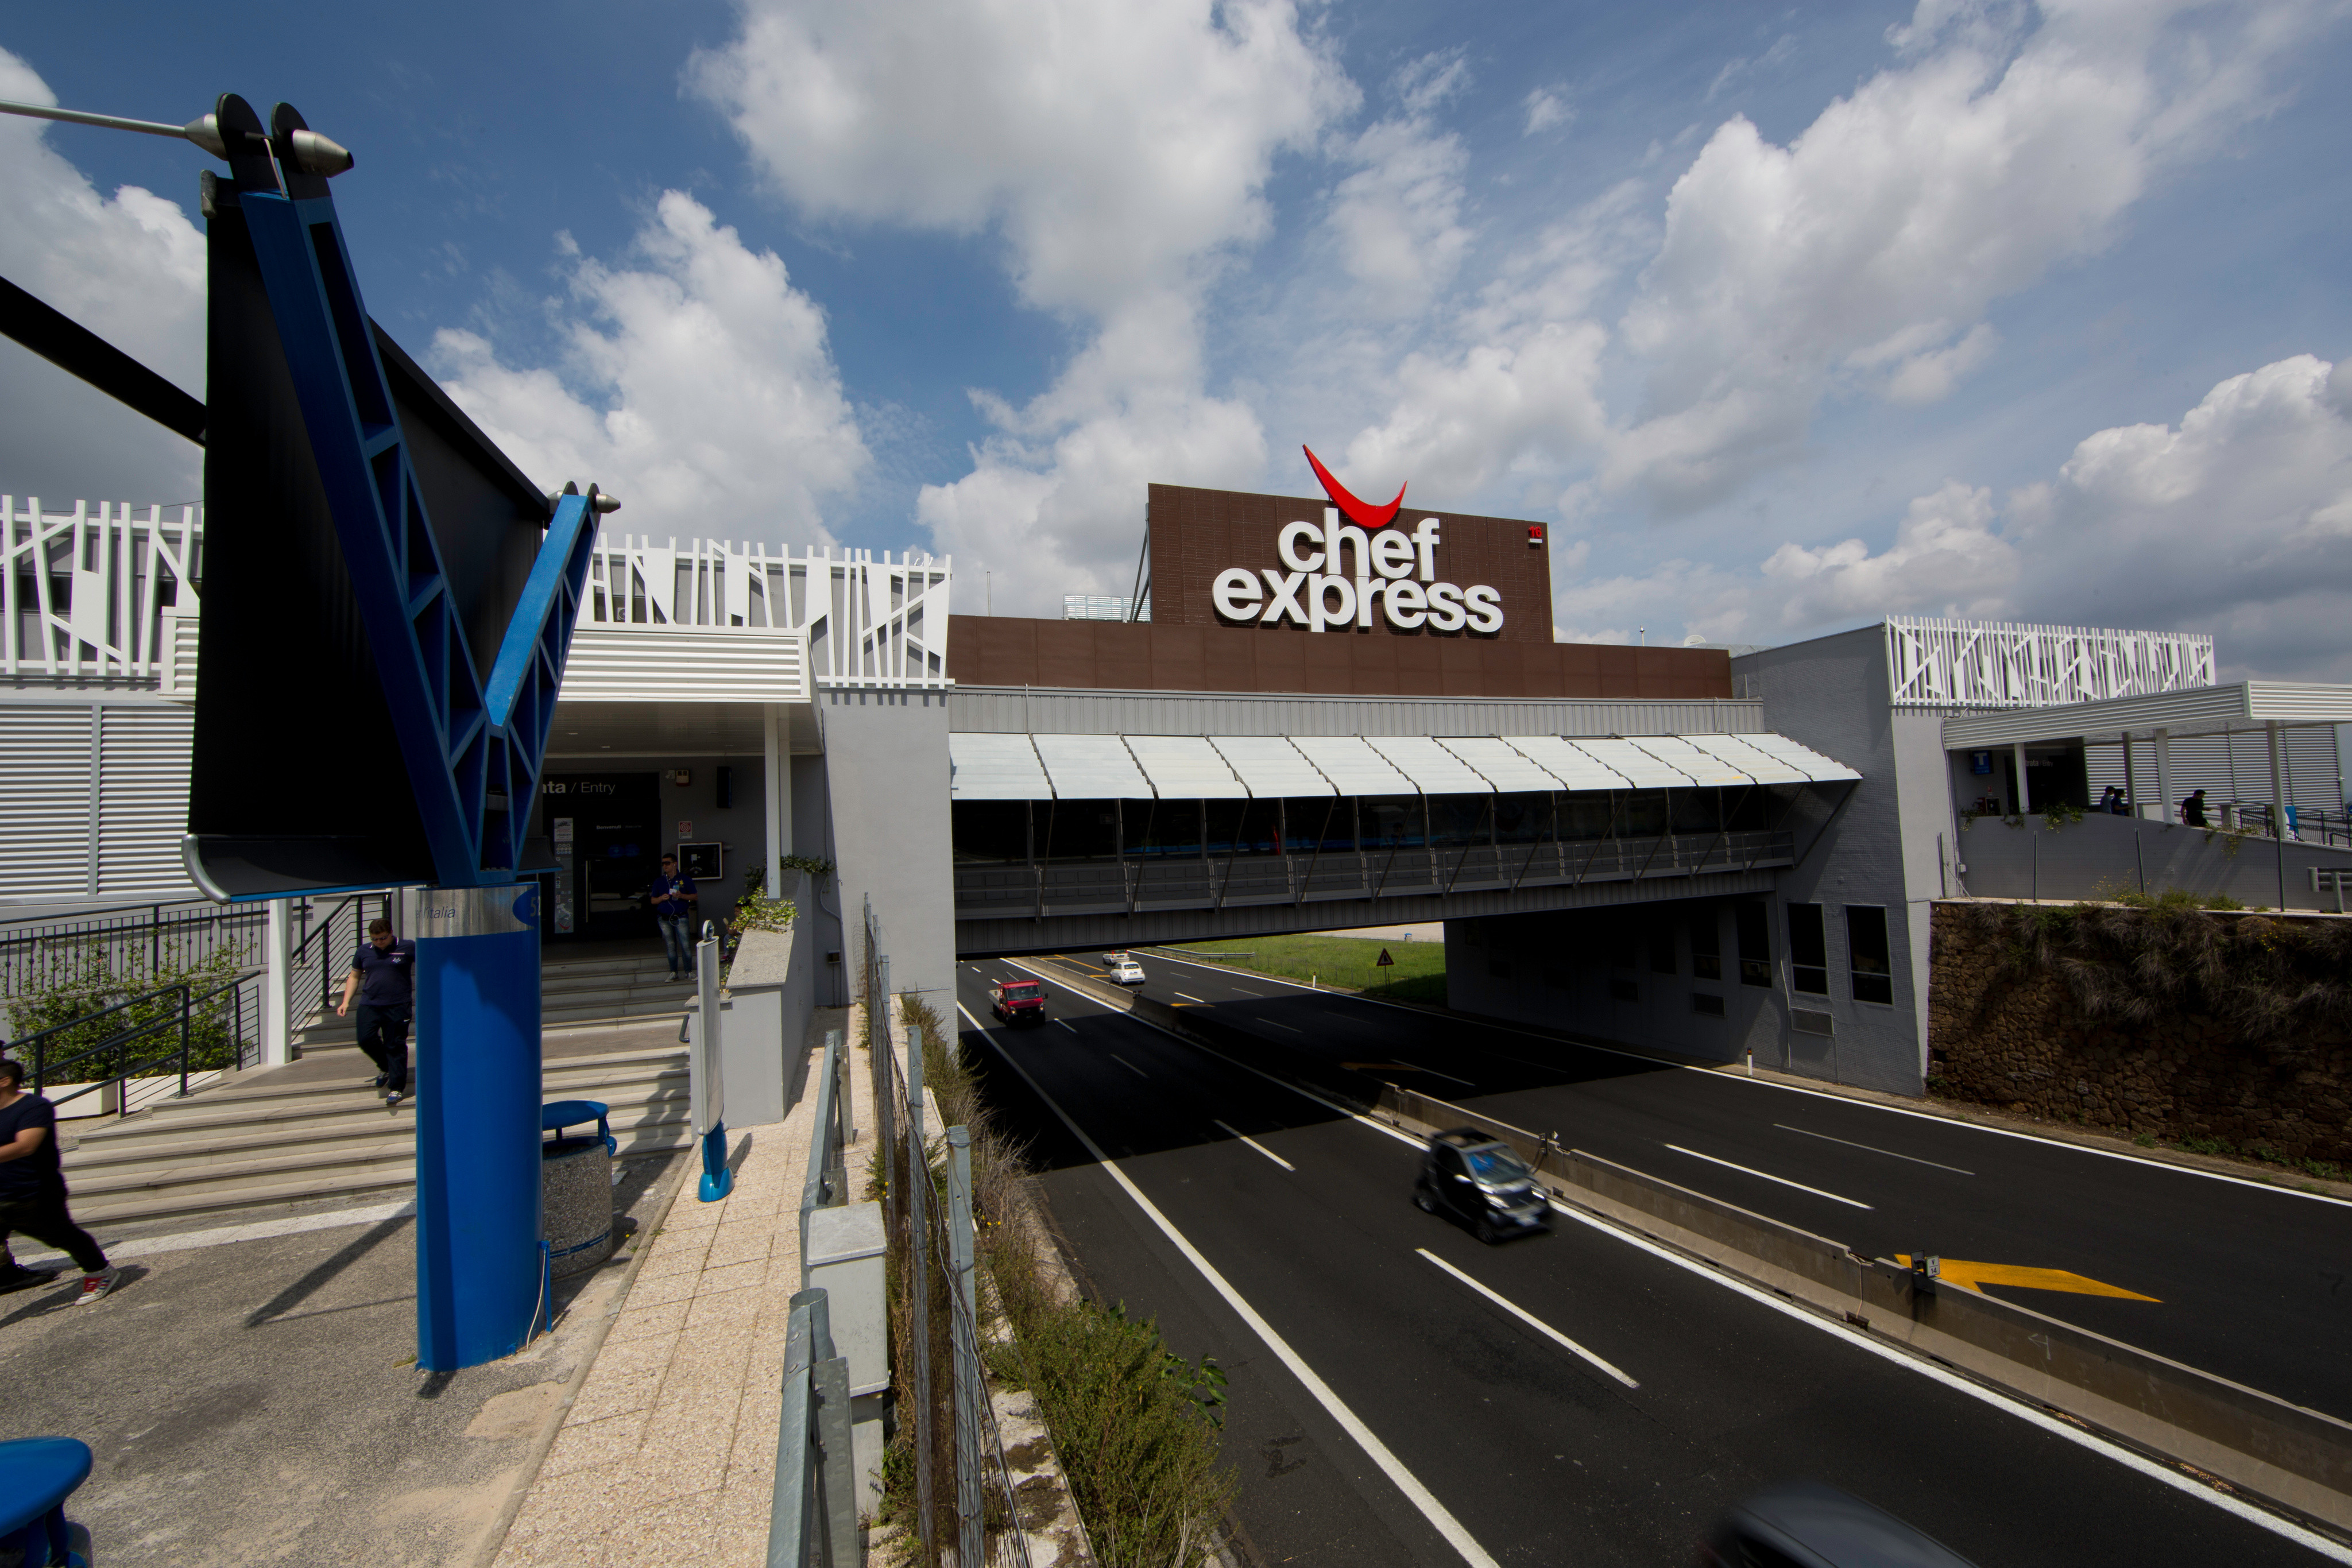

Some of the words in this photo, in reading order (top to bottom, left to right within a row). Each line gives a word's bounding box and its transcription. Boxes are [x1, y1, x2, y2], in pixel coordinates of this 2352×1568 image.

[1529, 526, 1542, 538] 16
[1278, 507, 1440, 582] chef
[1212, 567, 1504, 633] express
[1974, 752, 1987, 766] T
[570, 781, 577, 794] /
[581, 781, 616, 795] Entry
